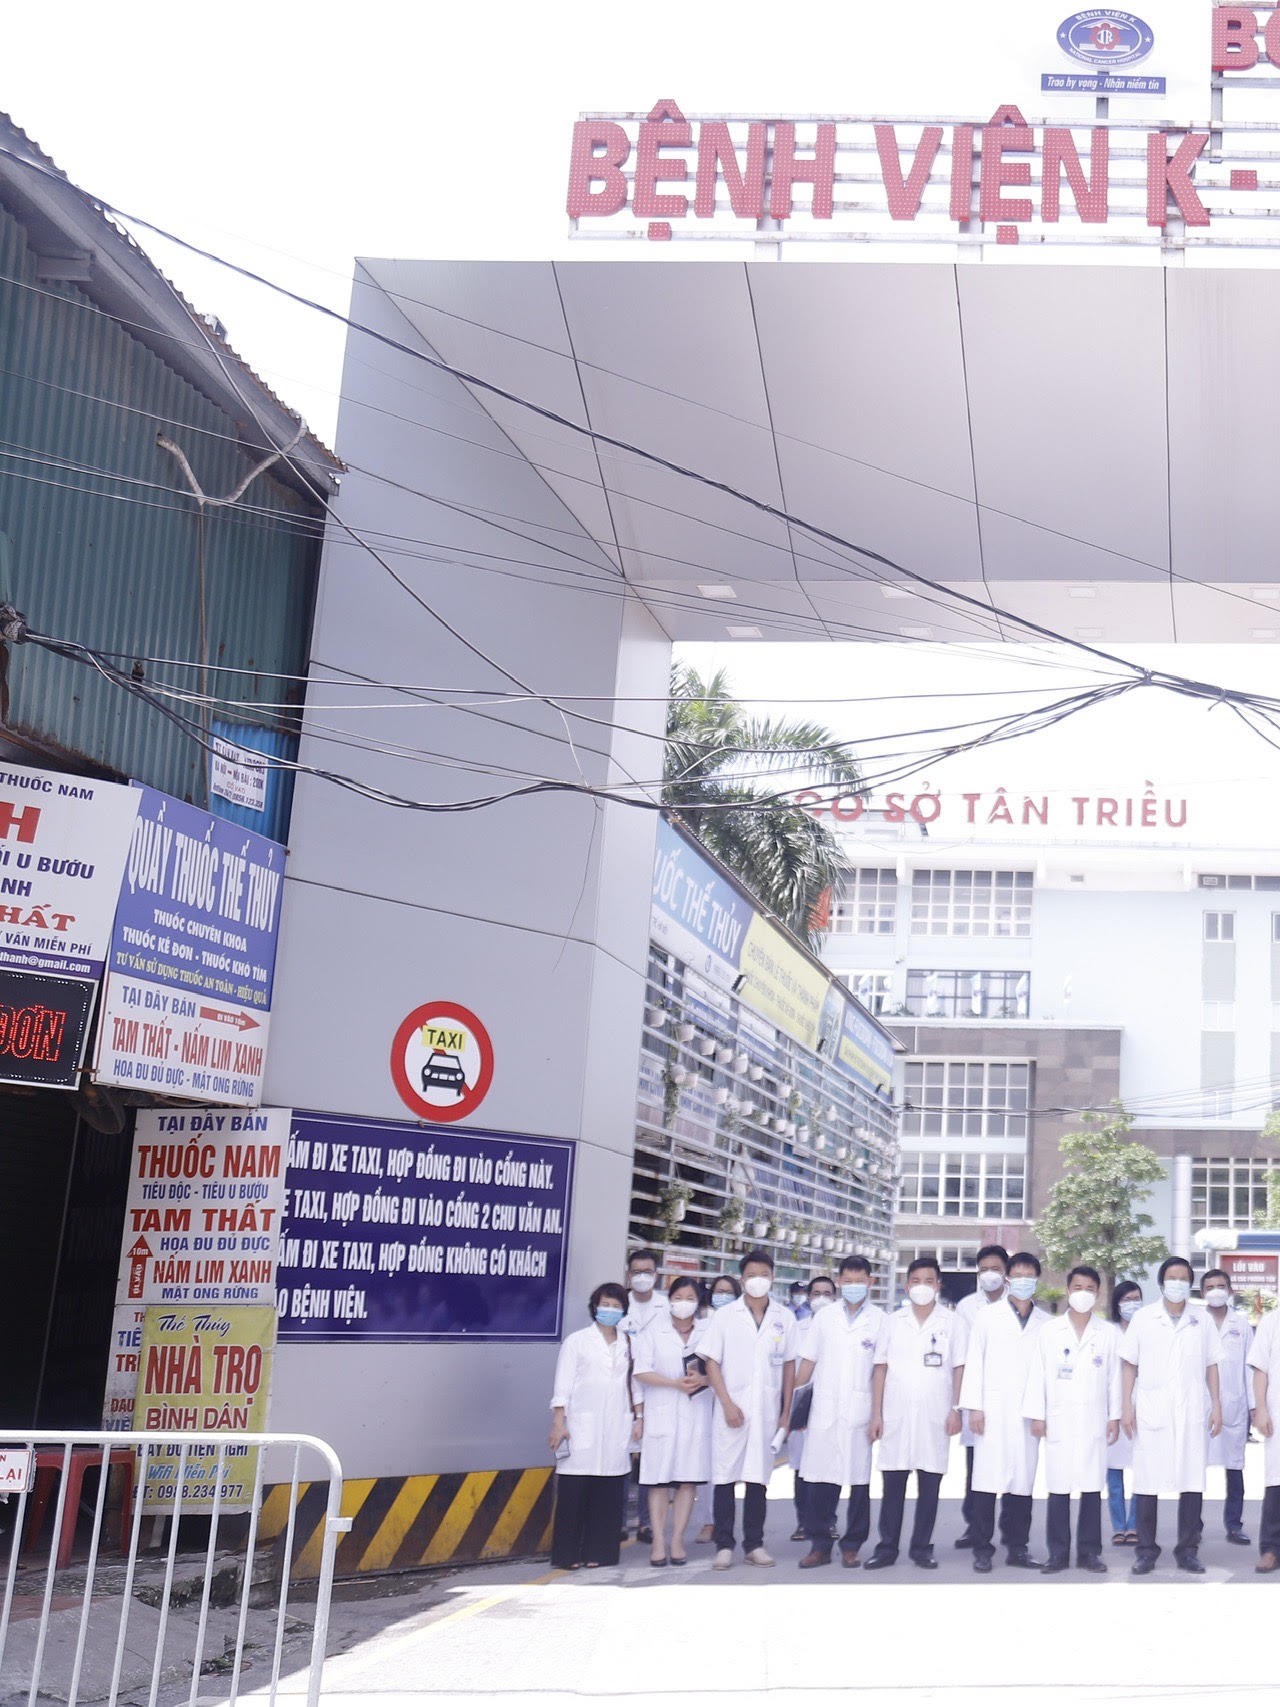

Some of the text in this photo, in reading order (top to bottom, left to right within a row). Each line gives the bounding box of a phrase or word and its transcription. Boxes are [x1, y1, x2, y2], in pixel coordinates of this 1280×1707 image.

[1047, 76, 1063, 87] Trao
[1066, 77, 1076, 89] hy
[566, 98, 835, 241] BỆNH
[873, 104, 1108, 245] VIỆN
[1147, 131, 1210, 227] K
[58, 784, 94, 800] NAM
[962, 787, 1048, 825] TÂN
[1072, 780, 1187, 827] TRIỀU
[17, 853, 32, 869] U
[37, 857, 95, 879] BƯỚU
[171, 821, 219, 912] THUỐC
[218, 839, 250, 922] THẾ
[681, 881, 716, 933] THẾ
[154, 909, 185, 932] THUỐC
[223, 932, 247, 953] KHOA
[70, 943, 93, 956] PHÍ
[122, 925, 156, 951] THUỐC
[201, 950, 230, 973] THUỐC
[123, 986, 197, 1018] TẠI ĐÂY BÁN
[112, 1016, 263, 1077] TAM THẤT NẤM LIM XANH
[428, 1029, 462, 1050] TAXI
[113, 1059, 133, 1078] HOA
[136, 1063, 149, 1080] ĐU
[151, 1061, 164, 1083] ĐỦ
[166, 1068, 185, 1089] ĐỰC
[213, 1075, 229, 1094] ONG
[158, 1113, 268, 1134] TẠI ĐÂY BÁN
[138, 1133, 281, 1178] THUỐC NAM
[312, 1142, 327, 1170] ĐI
[329, 1143, 348, 1173] XE
[351, 1145, 384, 1179] TAXI,
[387, 1147, 413, 1183] HỢP
[453, 1156, 467, 1182] ĐI
[469, 1153, 493, 1185] VÀO
[528, 1159, 554, 1190] NÀY.
[142, 1181, 165, 1199] TIÊU
[169, 1181, 191, 1202] ĐỘC
[202, 1181, 225, 1199] TIÊU
[239, 1181, 269, 1200] BƯỚU
[130, 1200, 276, 1232] TAM THẤT
[294, 1189, 327, 1223] TAXI,
[331, 1190, 360, 1227] HỢP
[402, 1196, 414, 1225] ĐI
[418, 1194, 443, 1226] VÀO
[480, 1203, 490, 1230] 2
[492, 1205, 516, 1232] CHU
[518, 1201, 542, 1233] VĂN
[542, 1209, 563, 1234] AN.
[160, 1233, 270, 1253] HOA ĐU ĐỦ ĐỰC
[302, 1240, 318, 1268] ĐI
[320, 1240, 339, 1269] XE
[342, 1241, 375, 1274] TAXI,
[378, 1241, 405, 1278] HỢP
[446, 1241, 487, 1275] KHÔNG
[489, 1244, 506, 1276] CÓ
[508, 1245, 547, 1278] KHÁCH
[153, 1251, 272, 1284] NẤM LIM XANH
[162, 1286, 190, 1301] MẬT
[193, 1288, 219, 1299] ONG
[291, 1283, 368, 1325] BỆNH VIỆN.
[144, 1335, 262, 1405] NHÀ TRỌ
[146, 1402, 248, 1430] BÌNH DÂN
